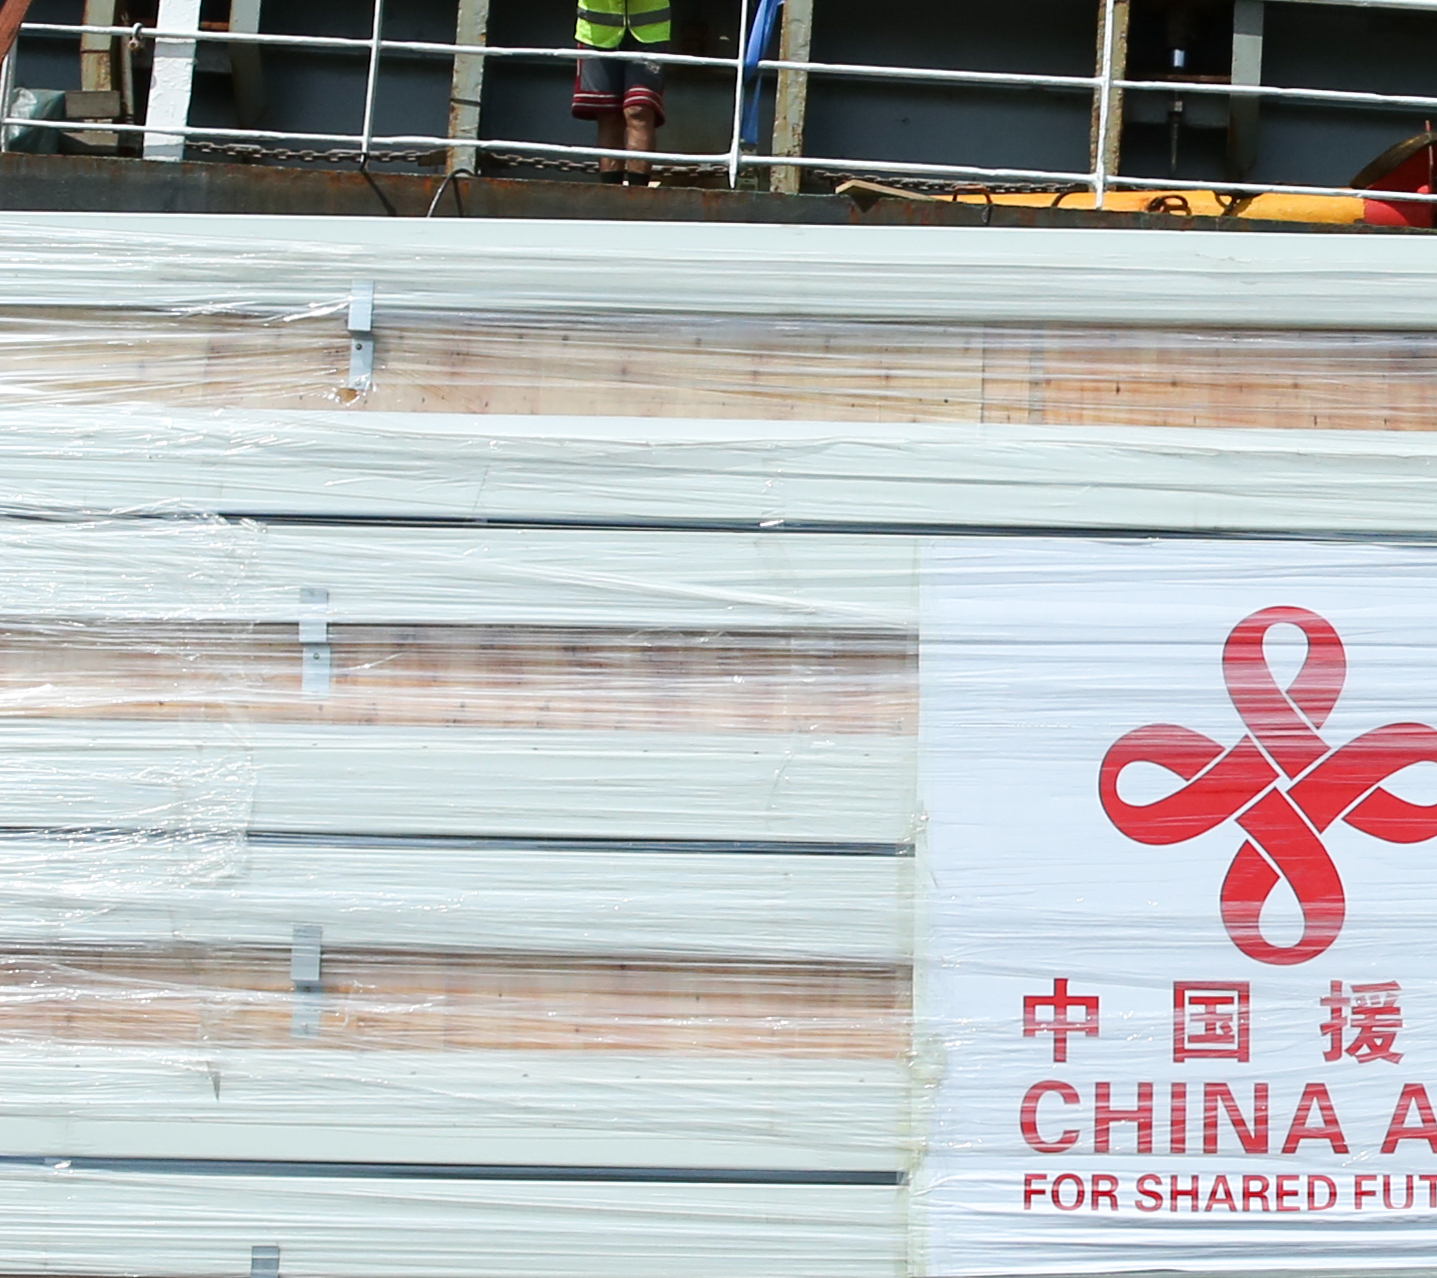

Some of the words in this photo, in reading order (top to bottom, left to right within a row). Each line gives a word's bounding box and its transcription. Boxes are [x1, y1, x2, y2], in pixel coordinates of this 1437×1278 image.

[1019, 1080, 1351, 1156] CHINA
[1022, 1173, 1119, 1212] FOR
[1134, 1173, 1338, 1213] SHARED
